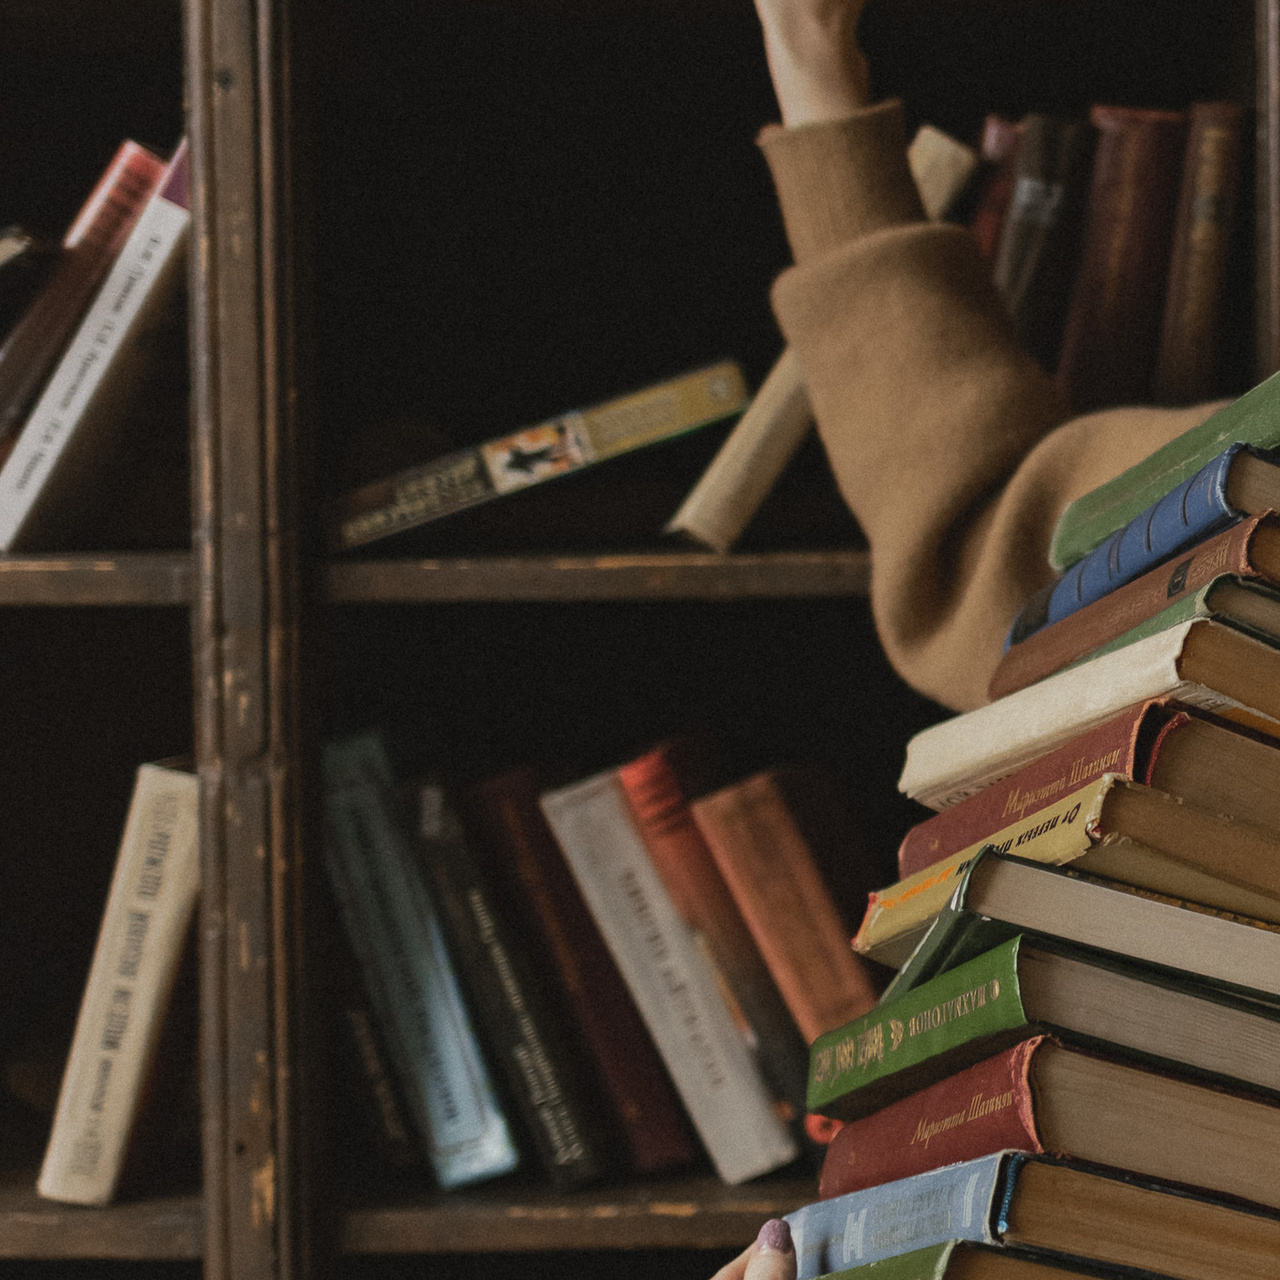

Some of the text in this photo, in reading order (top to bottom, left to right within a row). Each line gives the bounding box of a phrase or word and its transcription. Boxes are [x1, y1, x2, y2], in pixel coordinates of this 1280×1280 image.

[1001, 776, 1067, 820] Мариэтта
[1067, 748, 1121, 788] Шагинян
[910, 1089, 1014, 1150] Мариэтта Шагинян
